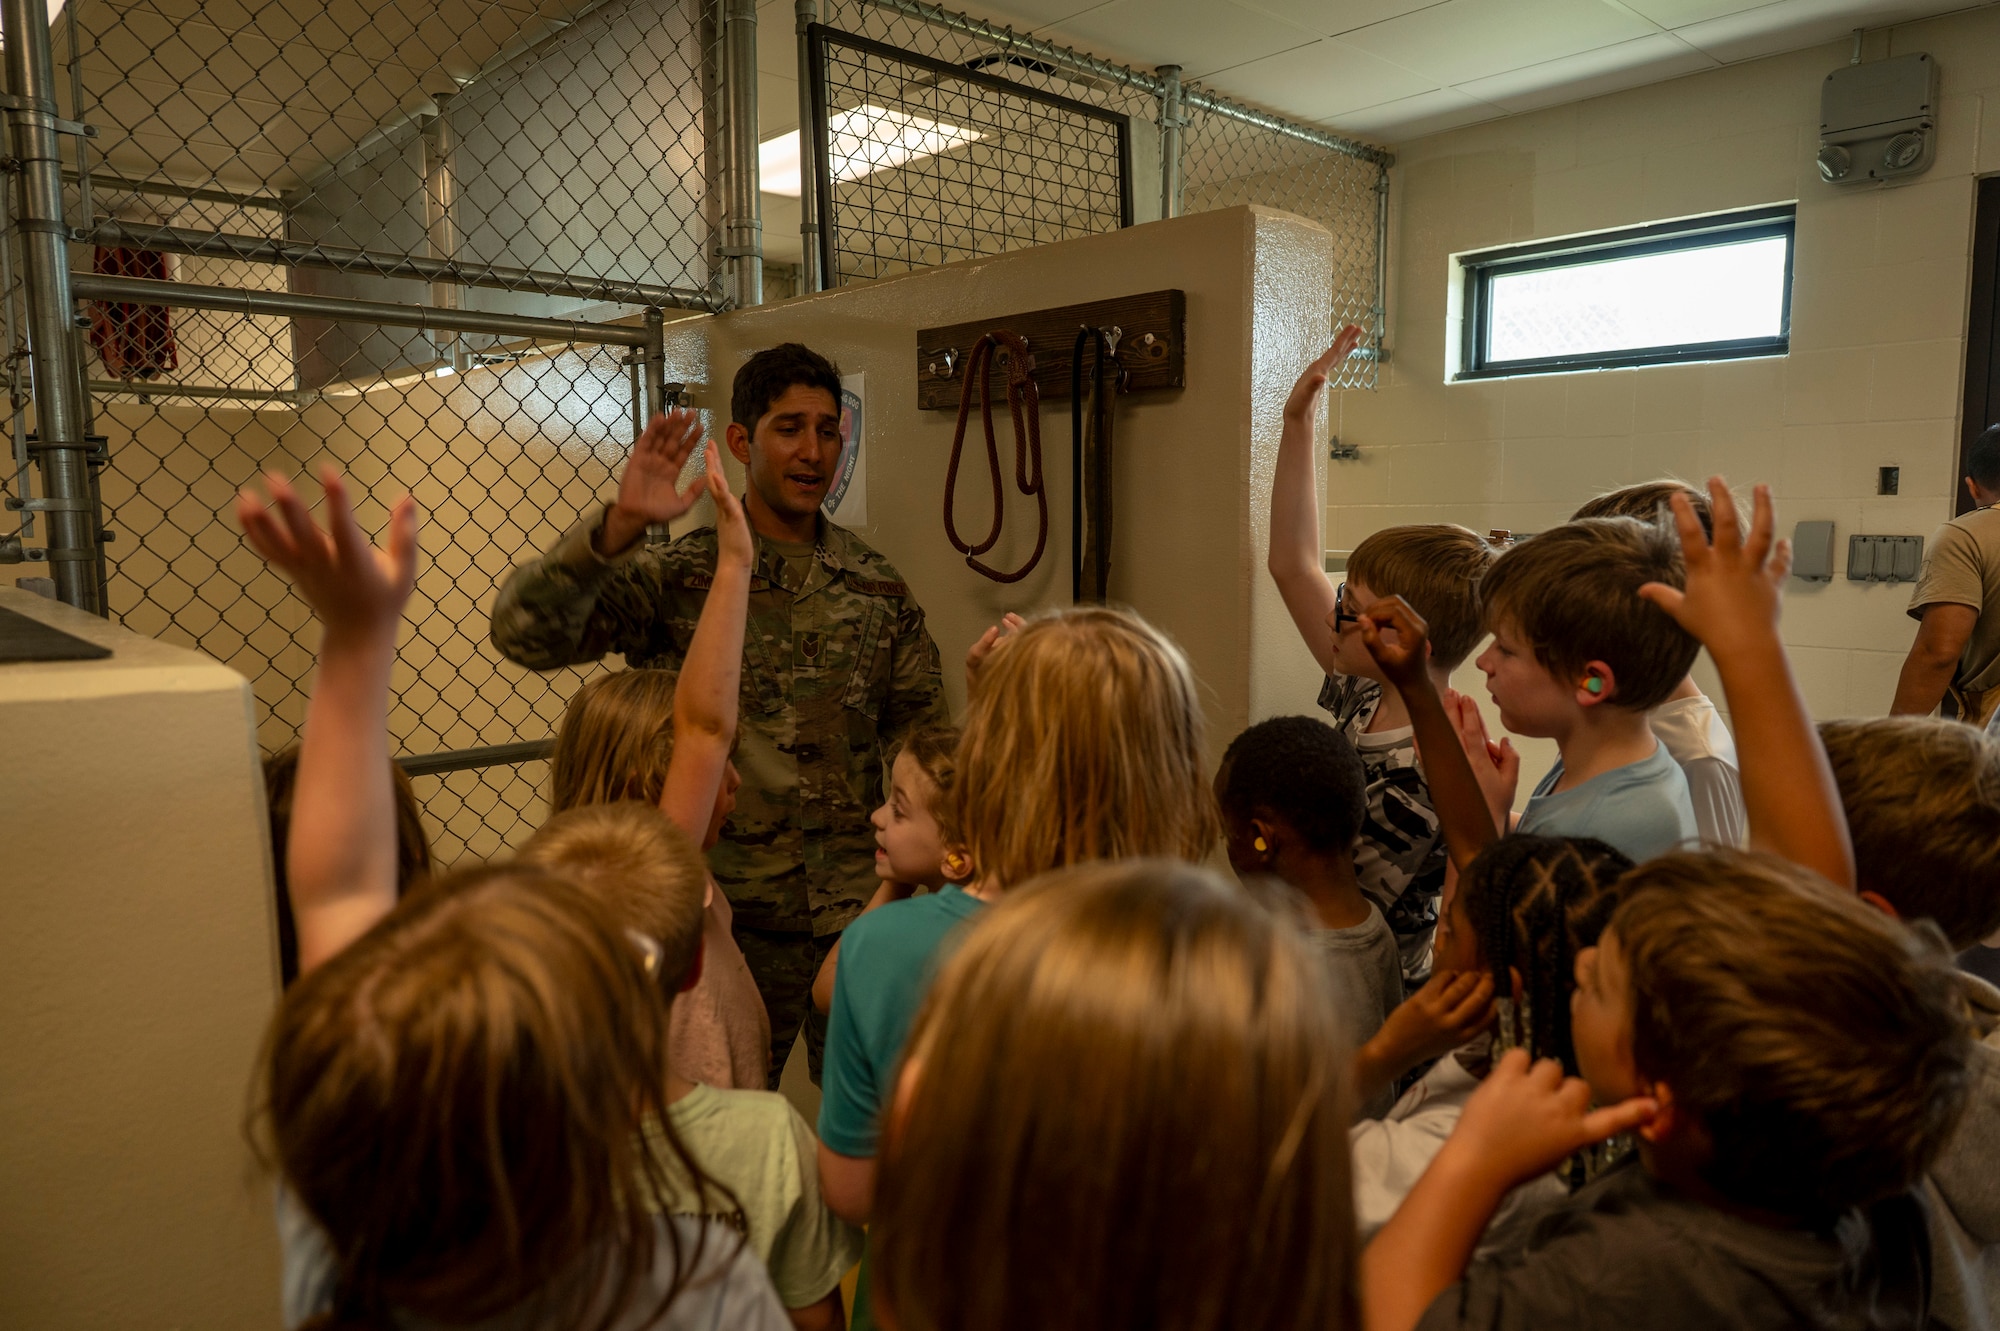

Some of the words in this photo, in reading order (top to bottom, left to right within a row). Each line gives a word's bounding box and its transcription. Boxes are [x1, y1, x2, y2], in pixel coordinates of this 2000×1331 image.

[848, 396, 860, 410] DOG
[827, 499, 836, 508] OF
[835, 482, 846, 499] THE
[843, 454, 855, 482] NIGHT
[862, 581, 878, 593] AIR
